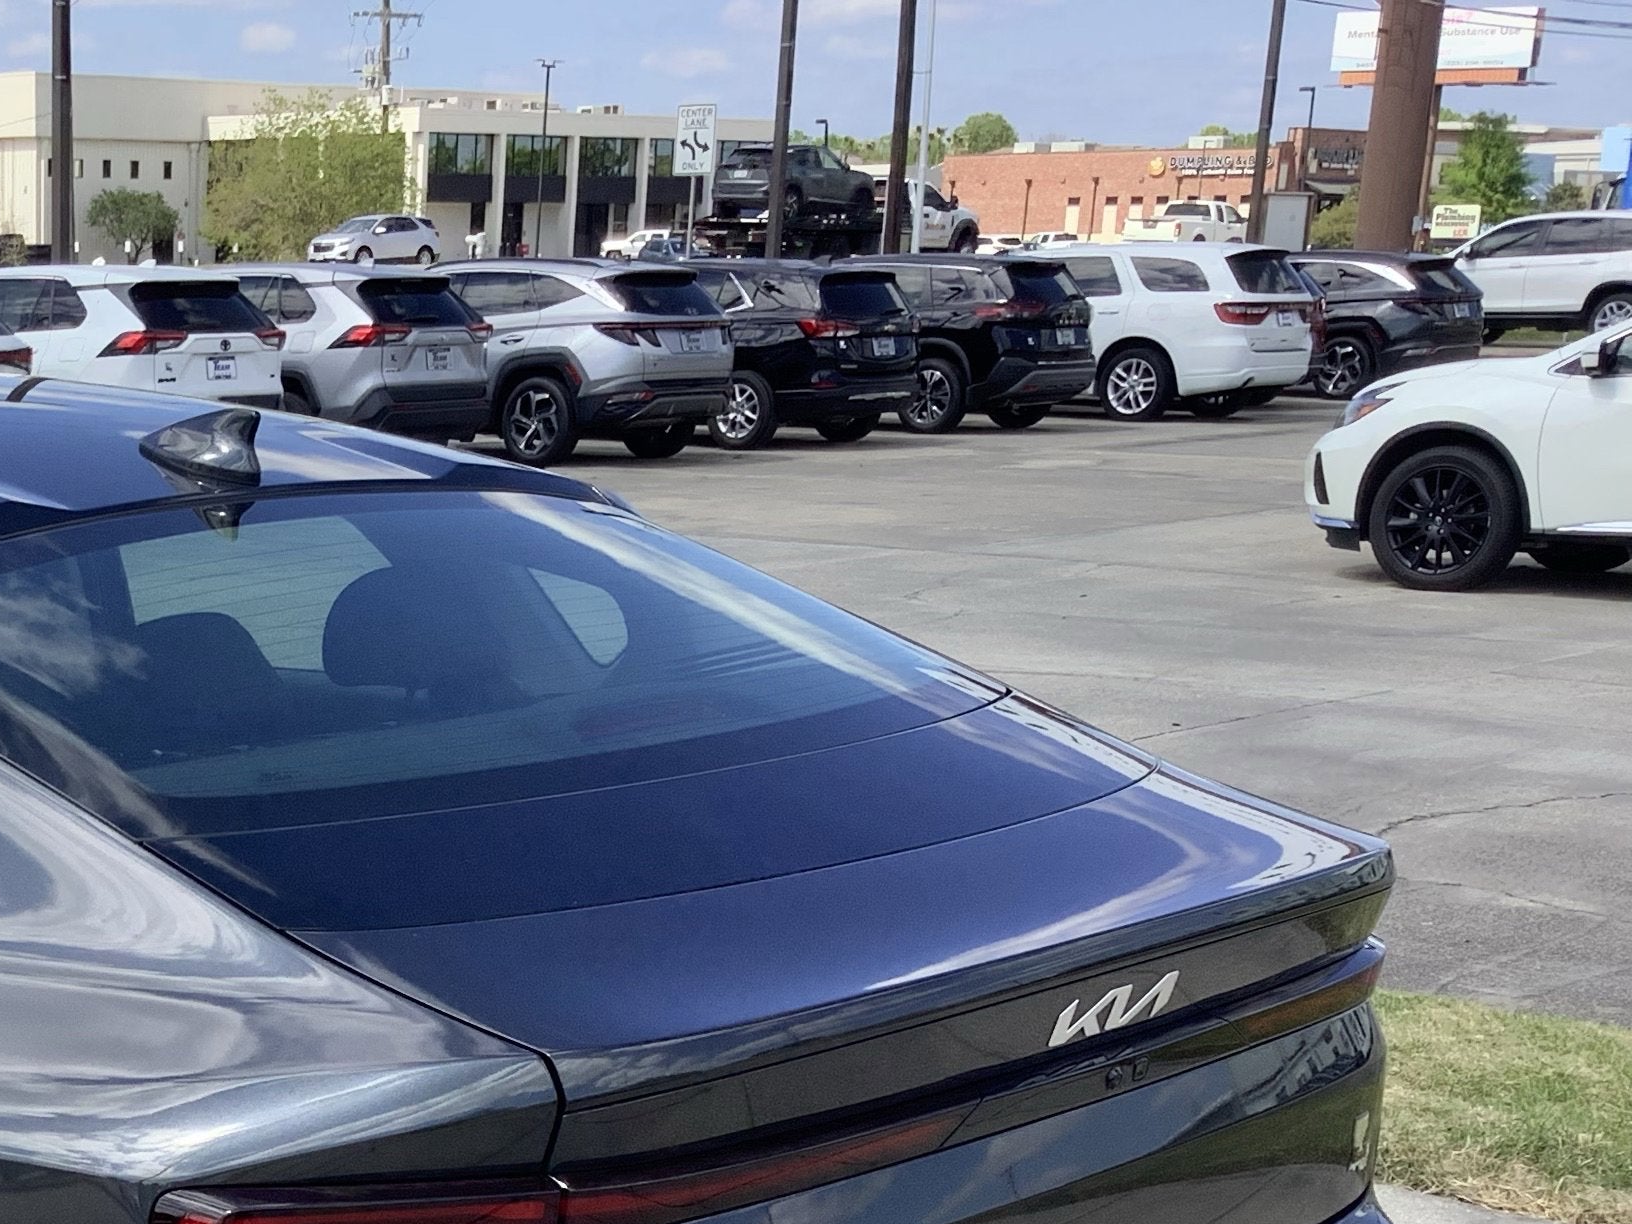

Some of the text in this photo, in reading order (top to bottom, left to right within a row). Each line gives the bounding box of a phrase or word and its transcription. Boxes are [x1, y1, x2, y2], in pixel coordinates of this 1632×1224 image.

[1441, 27, 1496, 38] Substance
[1499, 26, 1521, 37] Use
[680, 107, 714, 119] CENTER
[685, 118, 707, 128] LANE
[682, 161, 704, 171] ONLY
[1170, 155, 1231, 167] DUMPLING
[1048, 969, 1180, 1047] KIA
